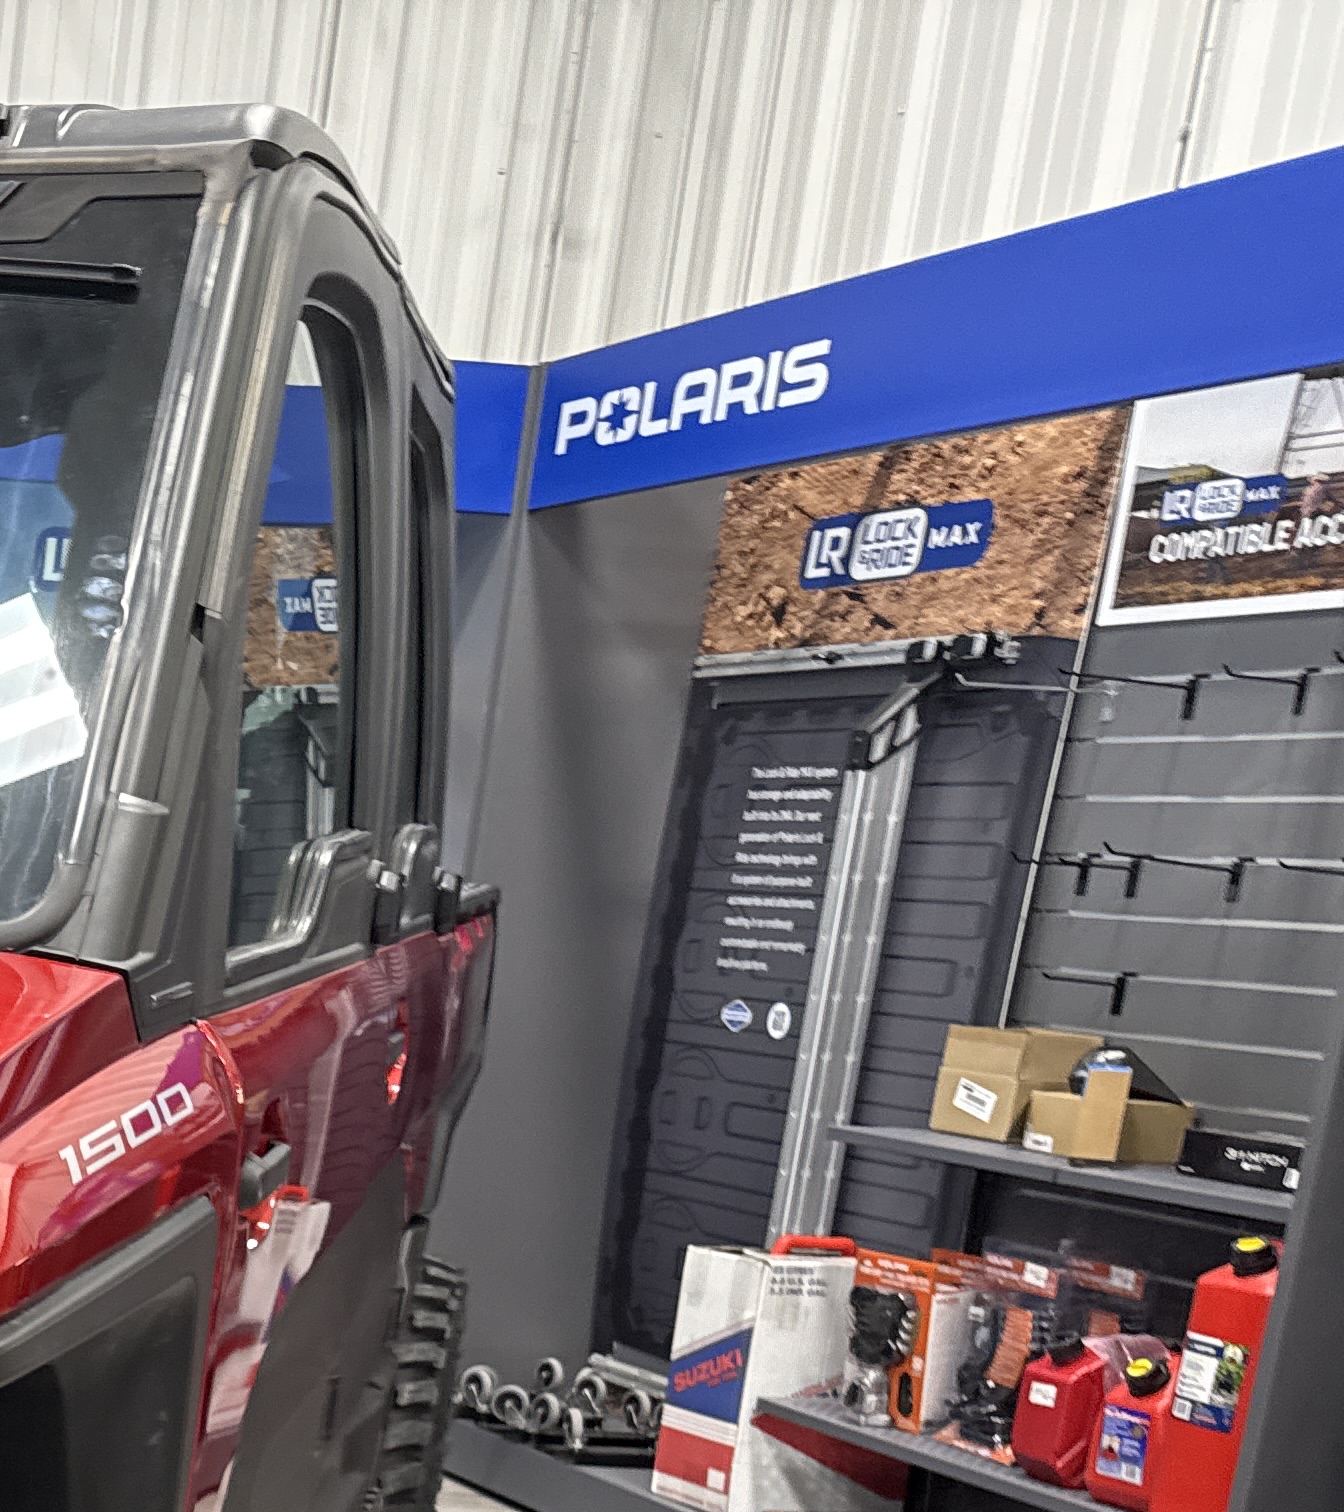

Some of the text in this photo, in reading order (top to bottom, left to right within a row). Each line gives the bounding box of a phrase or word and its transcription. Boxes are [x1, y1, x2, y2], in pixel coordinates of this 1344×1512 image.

[553, 339, 833, 456] POLARIS
[803, 521, 983, 580] LR MAX
[861, 516, 921, 545] LOCK
[1148, 519, 1296, 564] COMPATIBLE
[58, 1083, 194, 1185] 1500
[673, 1348, 744, 1393] SUZUKI
